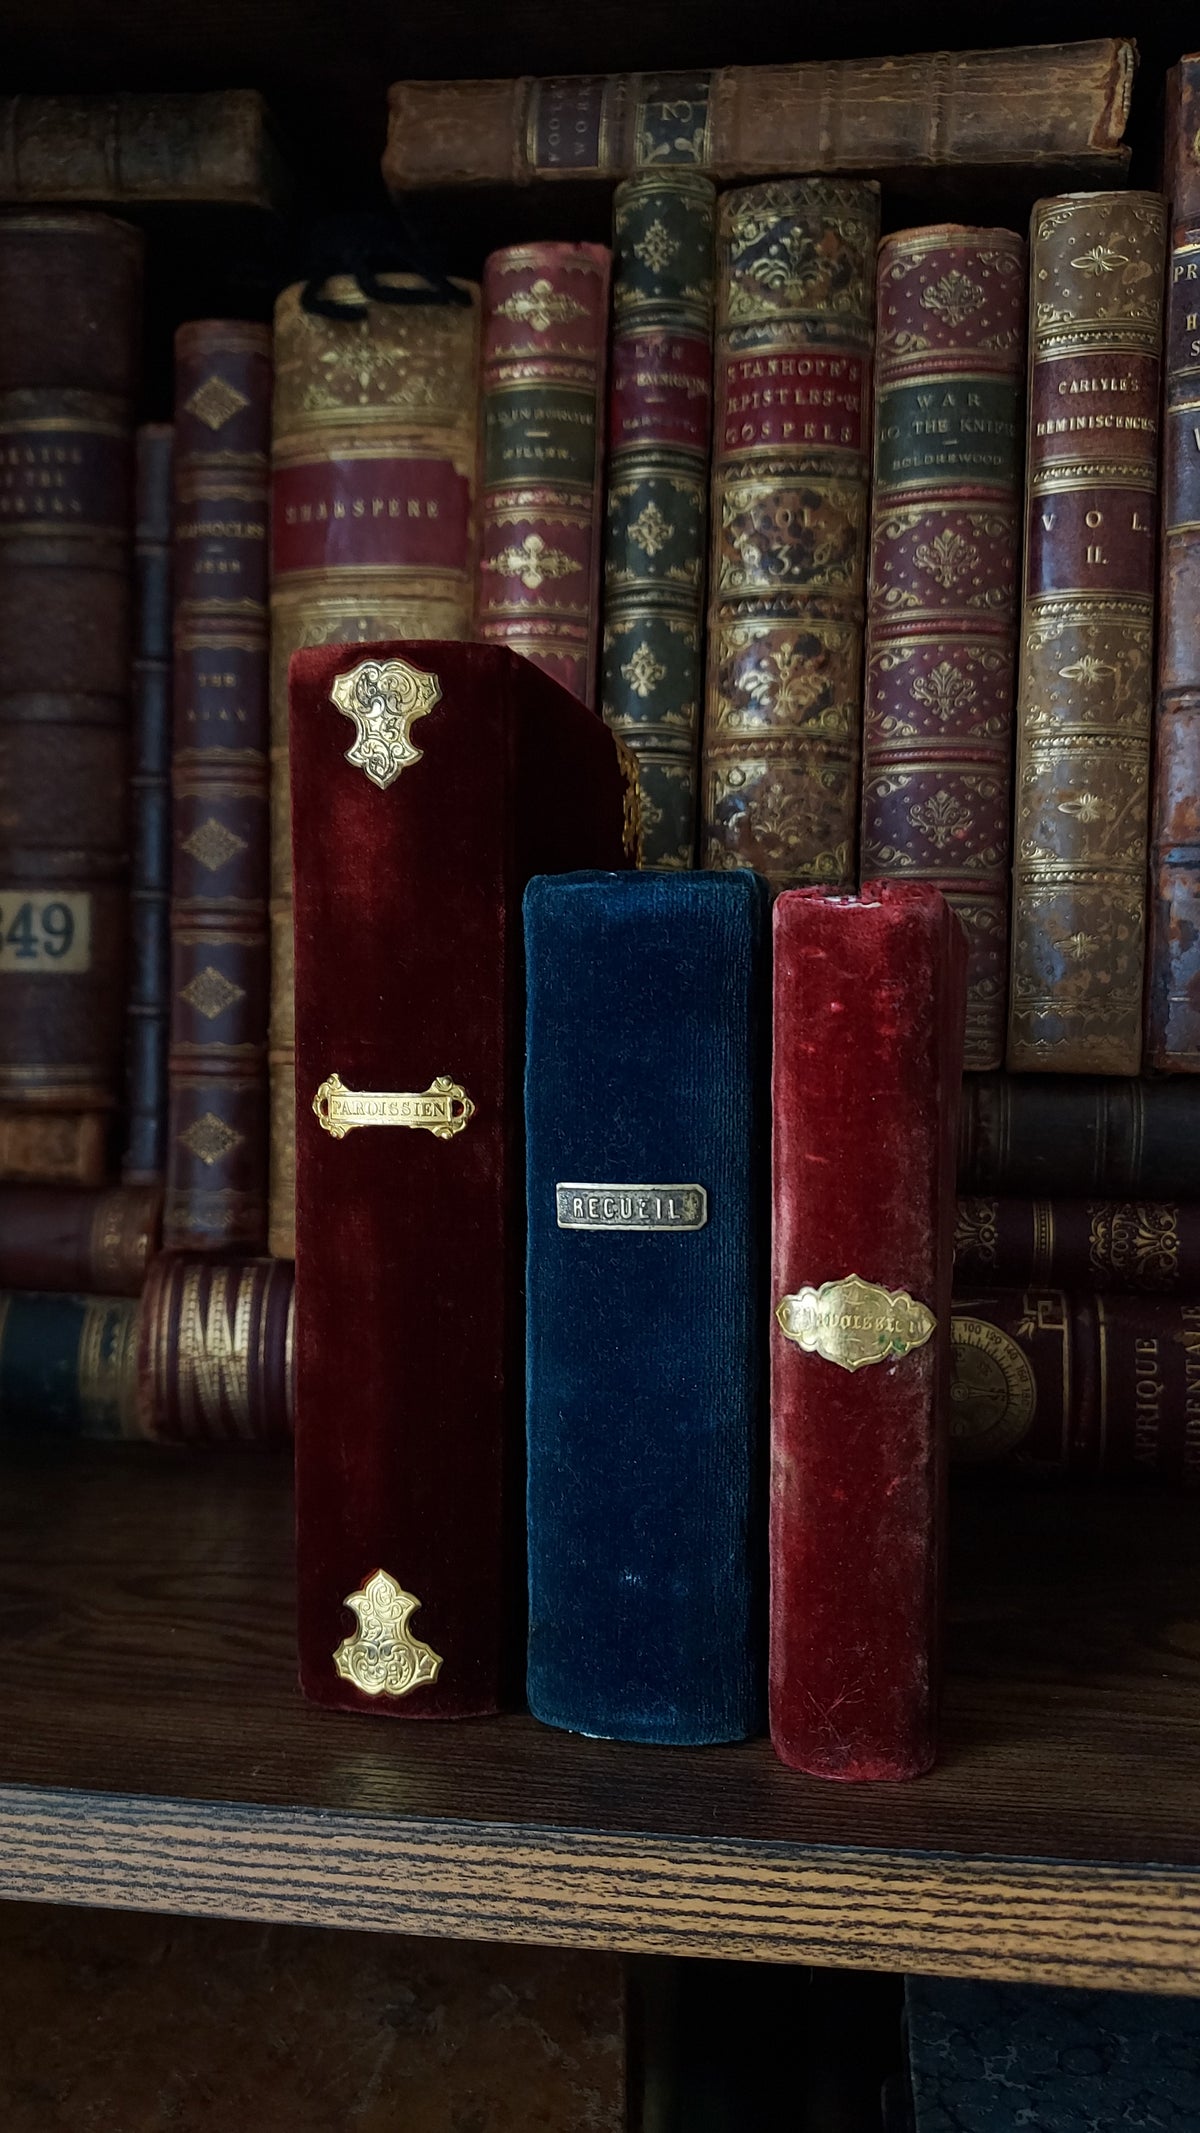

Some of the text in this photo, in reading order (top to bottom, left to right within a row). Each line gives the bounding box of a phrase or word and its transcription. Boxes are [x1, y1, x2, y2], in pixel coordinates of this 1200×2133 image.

[917, 391, 981, 408] WAR
[725, 421, 853, 444] GOSPELS
[912, 418, 949, 435] THE
[0, 902, 74, 958] 49
[331, 1101, 446, 1118] PAROISSIEN
[573, 1197, 681, 1220] RECUEIL
[963, 1322, 981, 1335] 100
